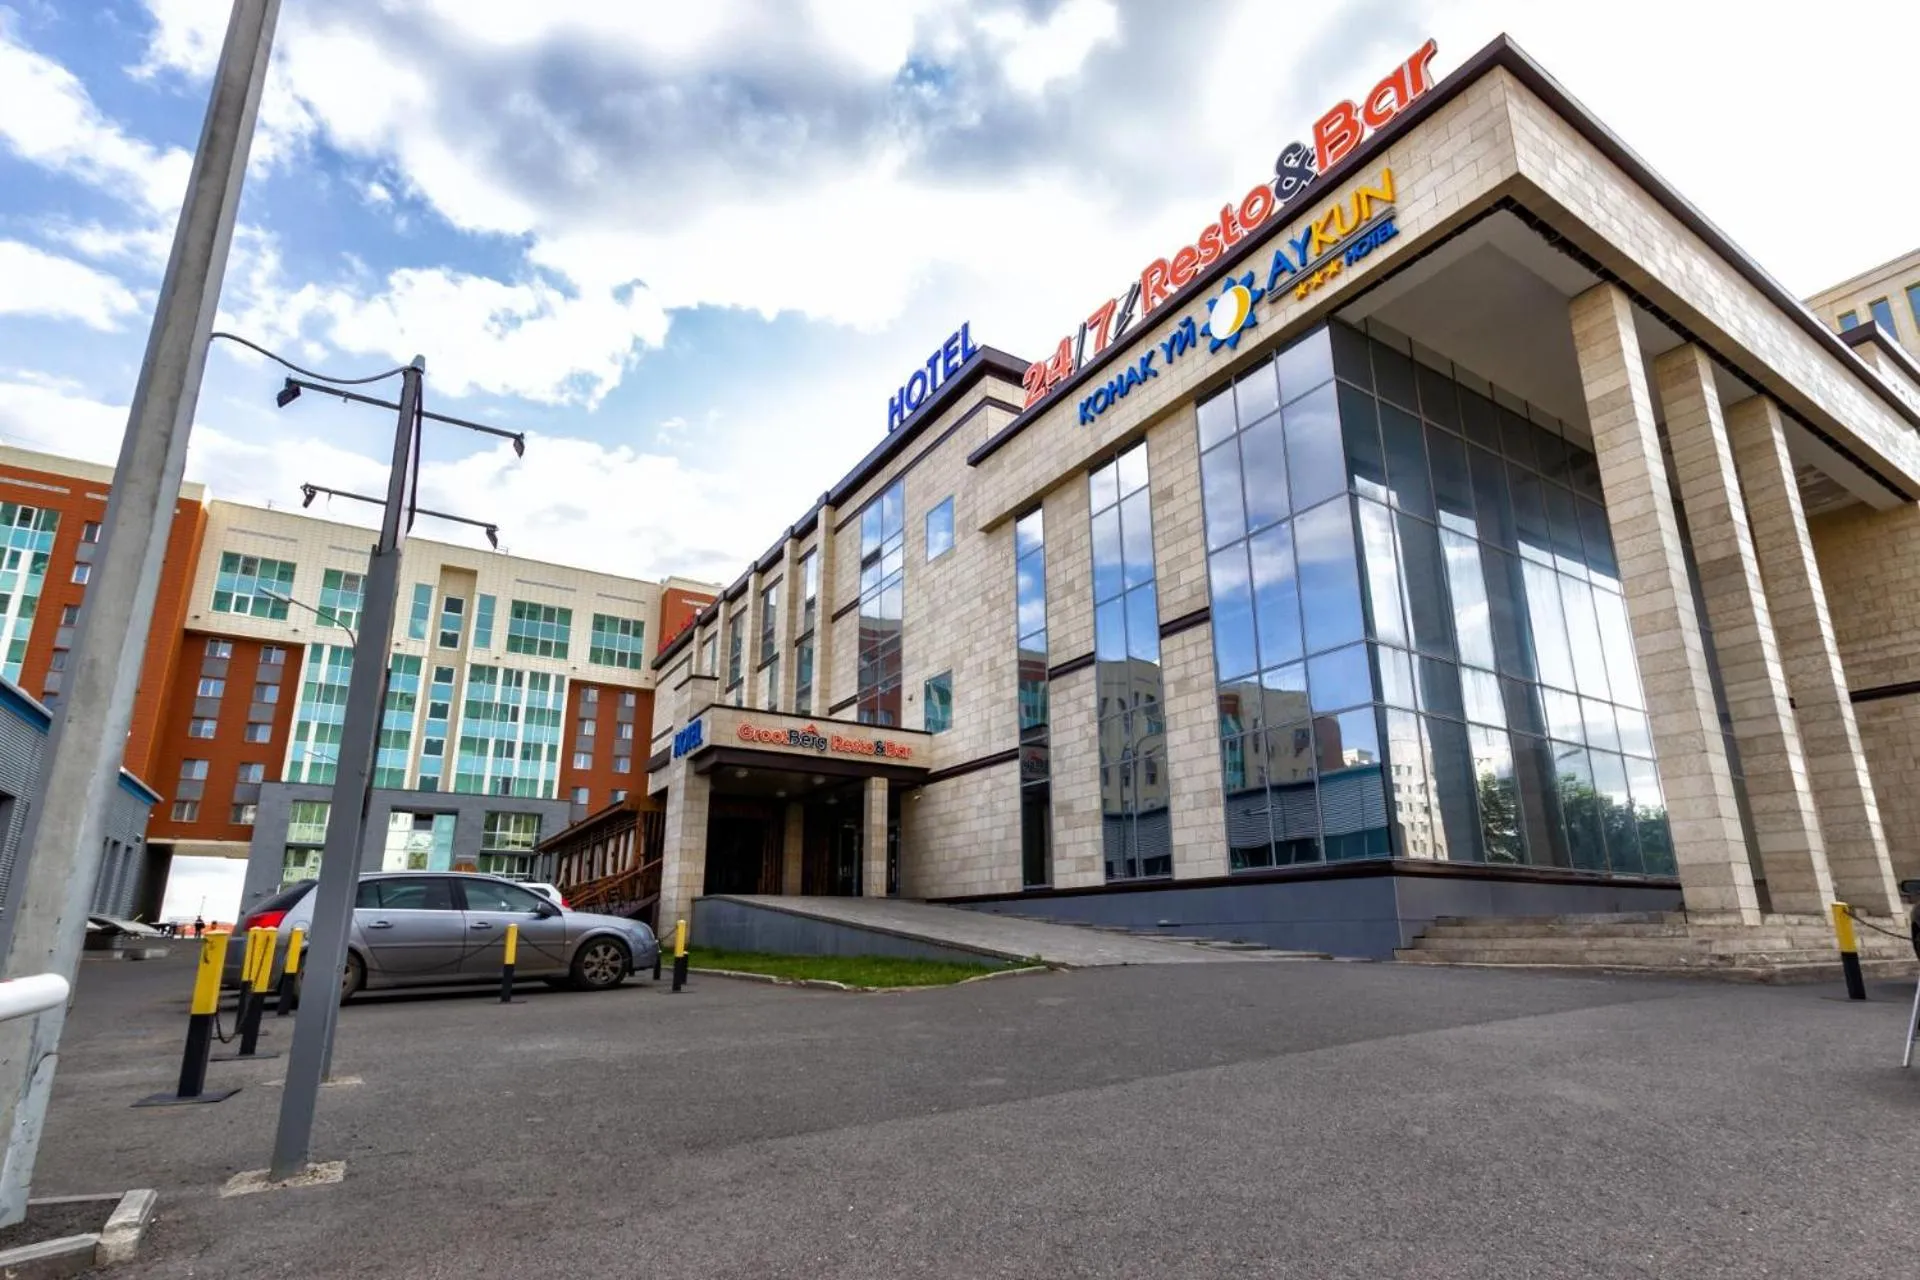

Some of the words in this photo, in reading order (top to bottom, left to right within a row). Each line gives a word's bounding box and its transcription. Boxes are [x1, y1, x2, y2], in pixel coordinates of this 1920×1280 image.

[1021, 298, 1118, 412] 24/7
[1139, 37, 1438, 317] Resto&Bar
[1267, 167, 1396, 292] AYKUN
[1344, 218, 1400, 267] HOTEL
[887, 319, 978, 434] HOTEL
